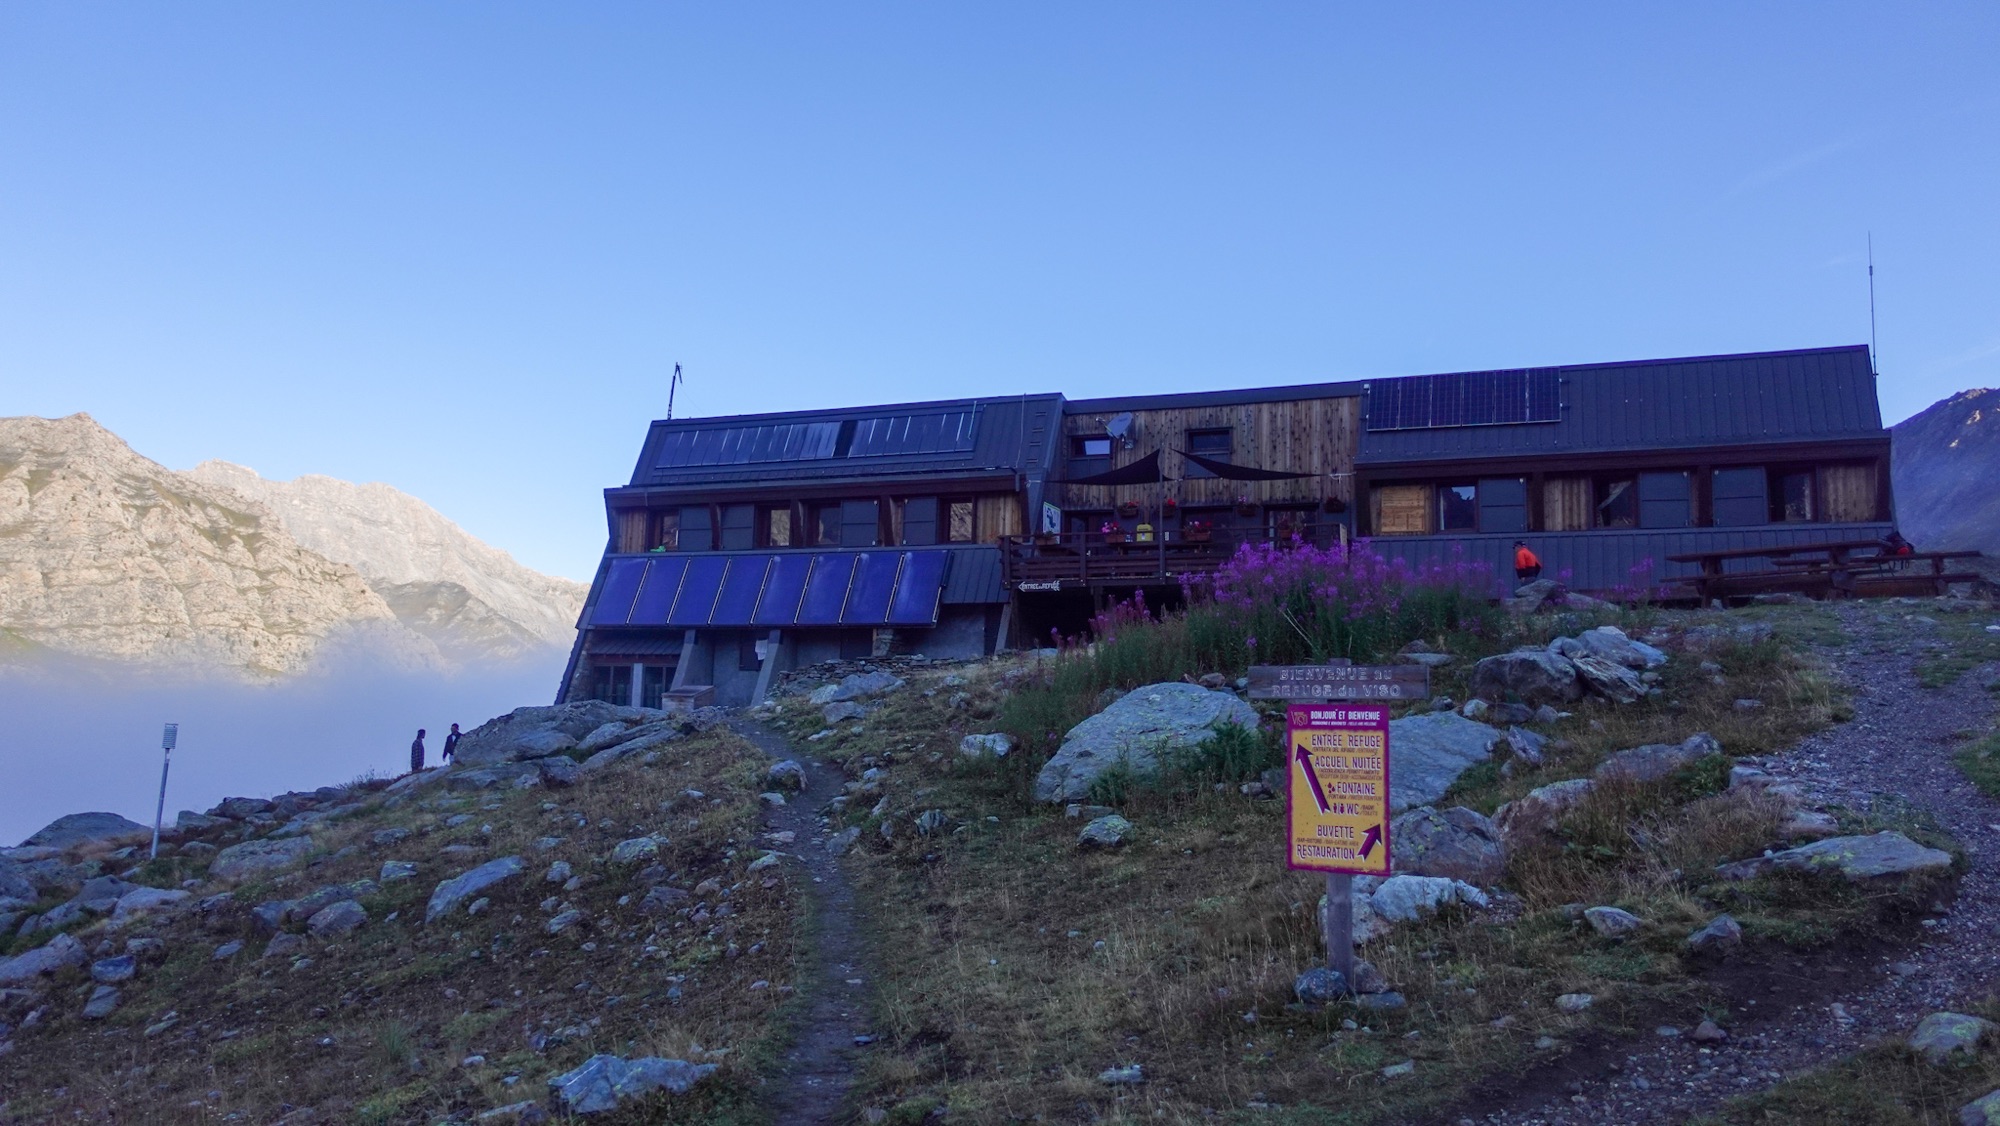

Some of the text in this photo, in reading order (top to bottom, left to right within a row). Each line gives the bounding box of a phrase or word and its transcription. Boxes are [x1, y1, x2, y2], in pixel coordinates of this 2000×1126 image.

[1280, 668, 1368, 681] BIENVENUE
[1271, 684, 1401, 697] REFUGE du VISO
[1310, 711, 1380, 720] BONJOUR ET BIENVENUE
[1312, 732, 1380, 747] ENTRÉE REFUGE
[1315, 755, 1381, 770] ACCUEIL NUITÉE
[1337, 782, 1376, 796] FONTAINE
[1347, 803, 1359, 815] WC
[1317, 825, 1354, 838] BUVETTE
[1296, 844, 1355, 860] RESTAURATION
